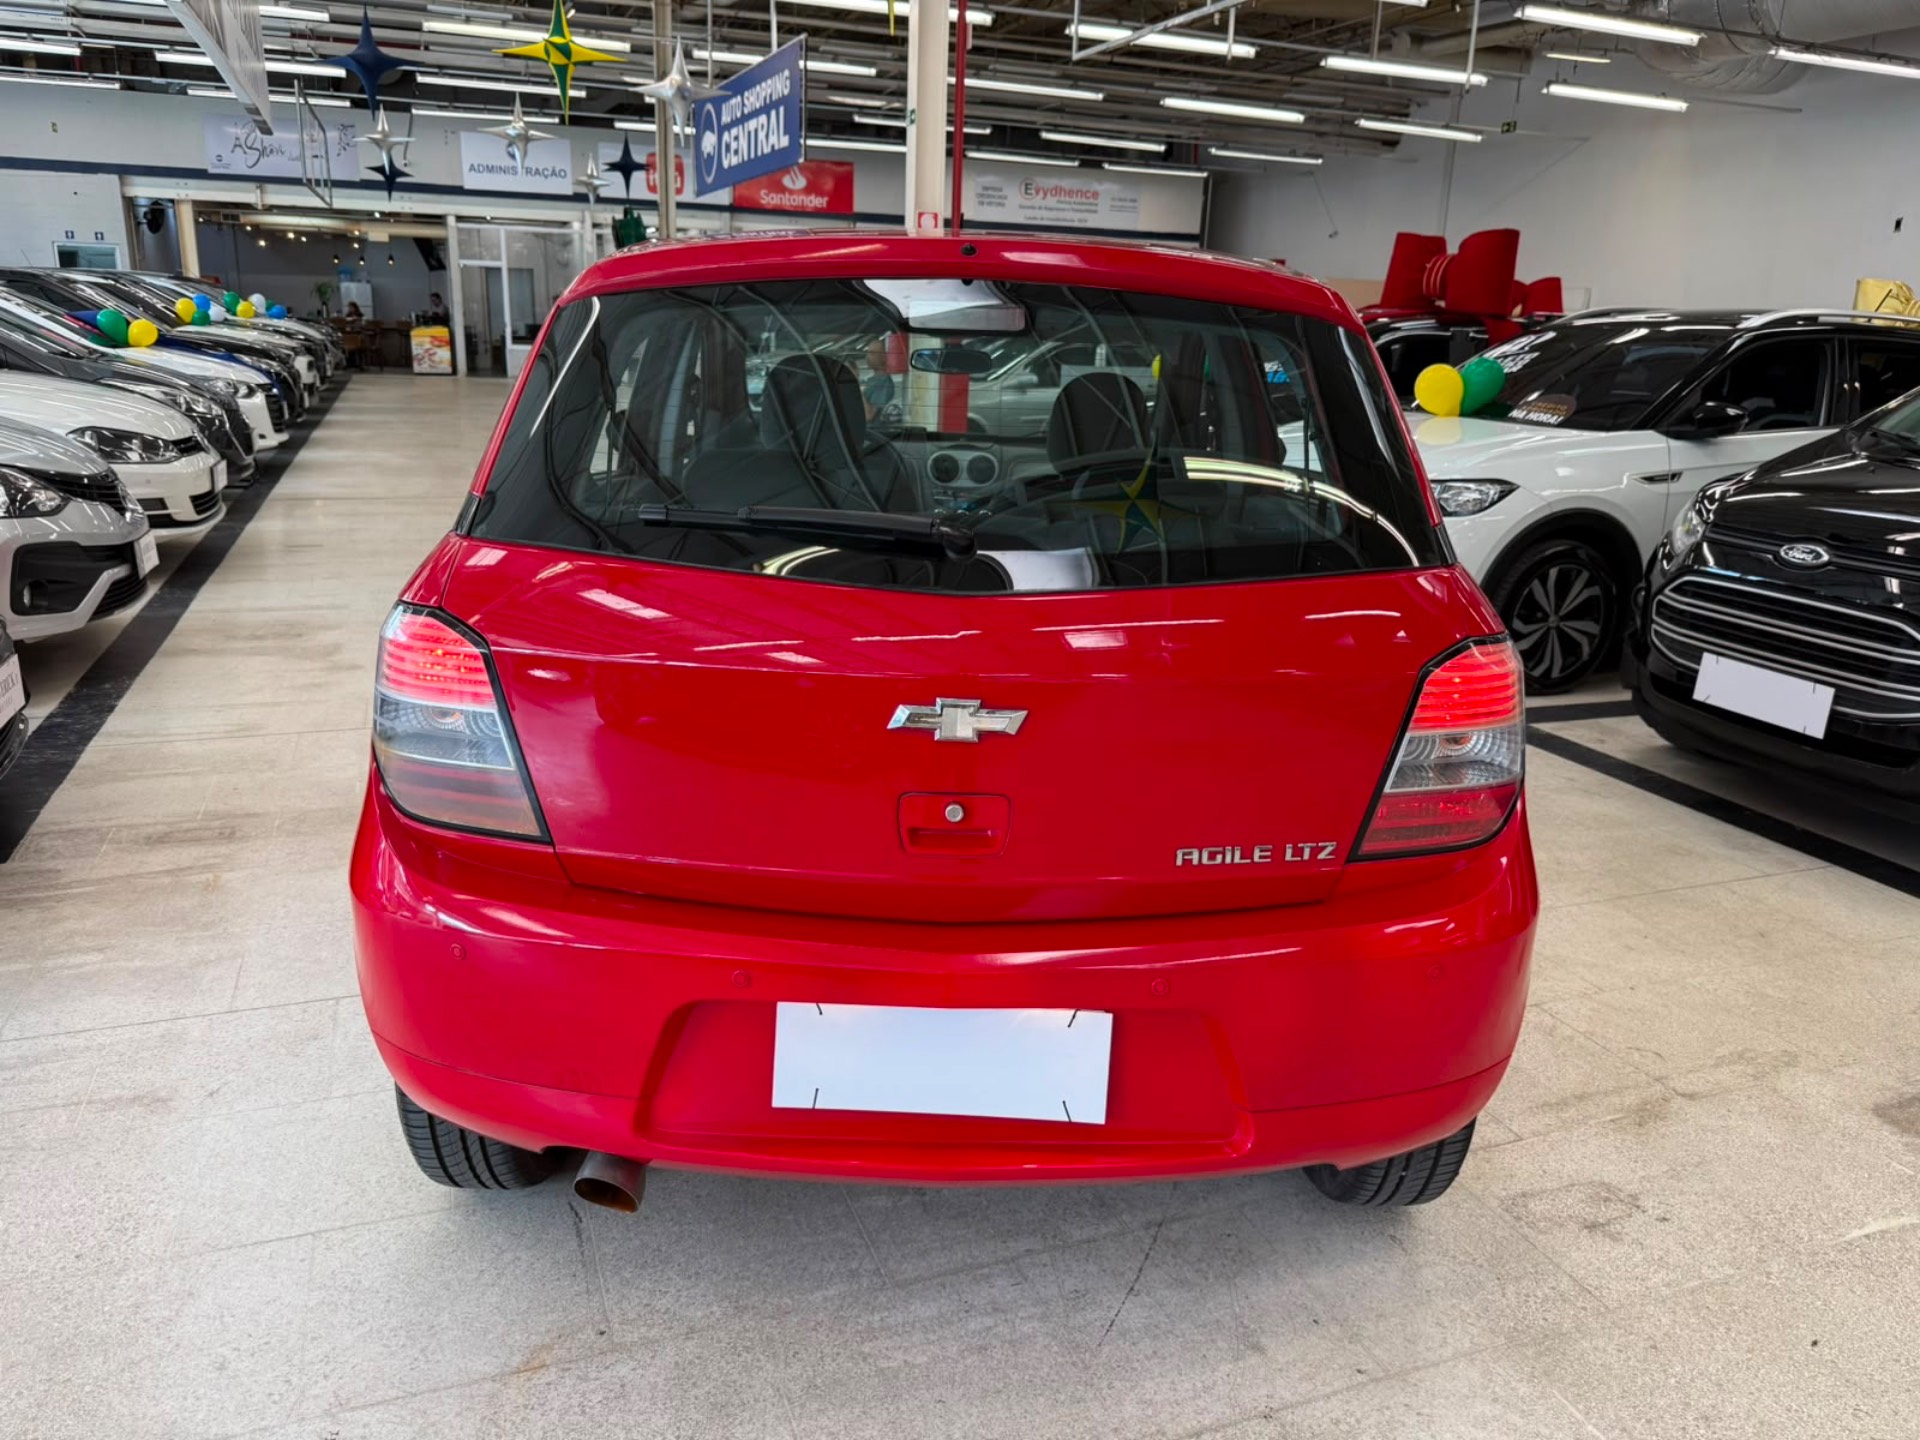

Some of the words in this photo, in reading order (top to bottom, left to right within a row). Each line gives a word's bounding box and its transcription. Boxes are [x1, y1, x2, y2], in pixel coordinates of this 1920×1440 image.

[720, 95, 743, 126] AUTO
[743, 69, 791, 115] SHOPPING
[721, 105, 790, 170] CENTRAL
[760, 189, 829, 208] Santander
[1024, 181, 1100, 201] Evydhence
[1284, 841, 1338, 862] LTZ
